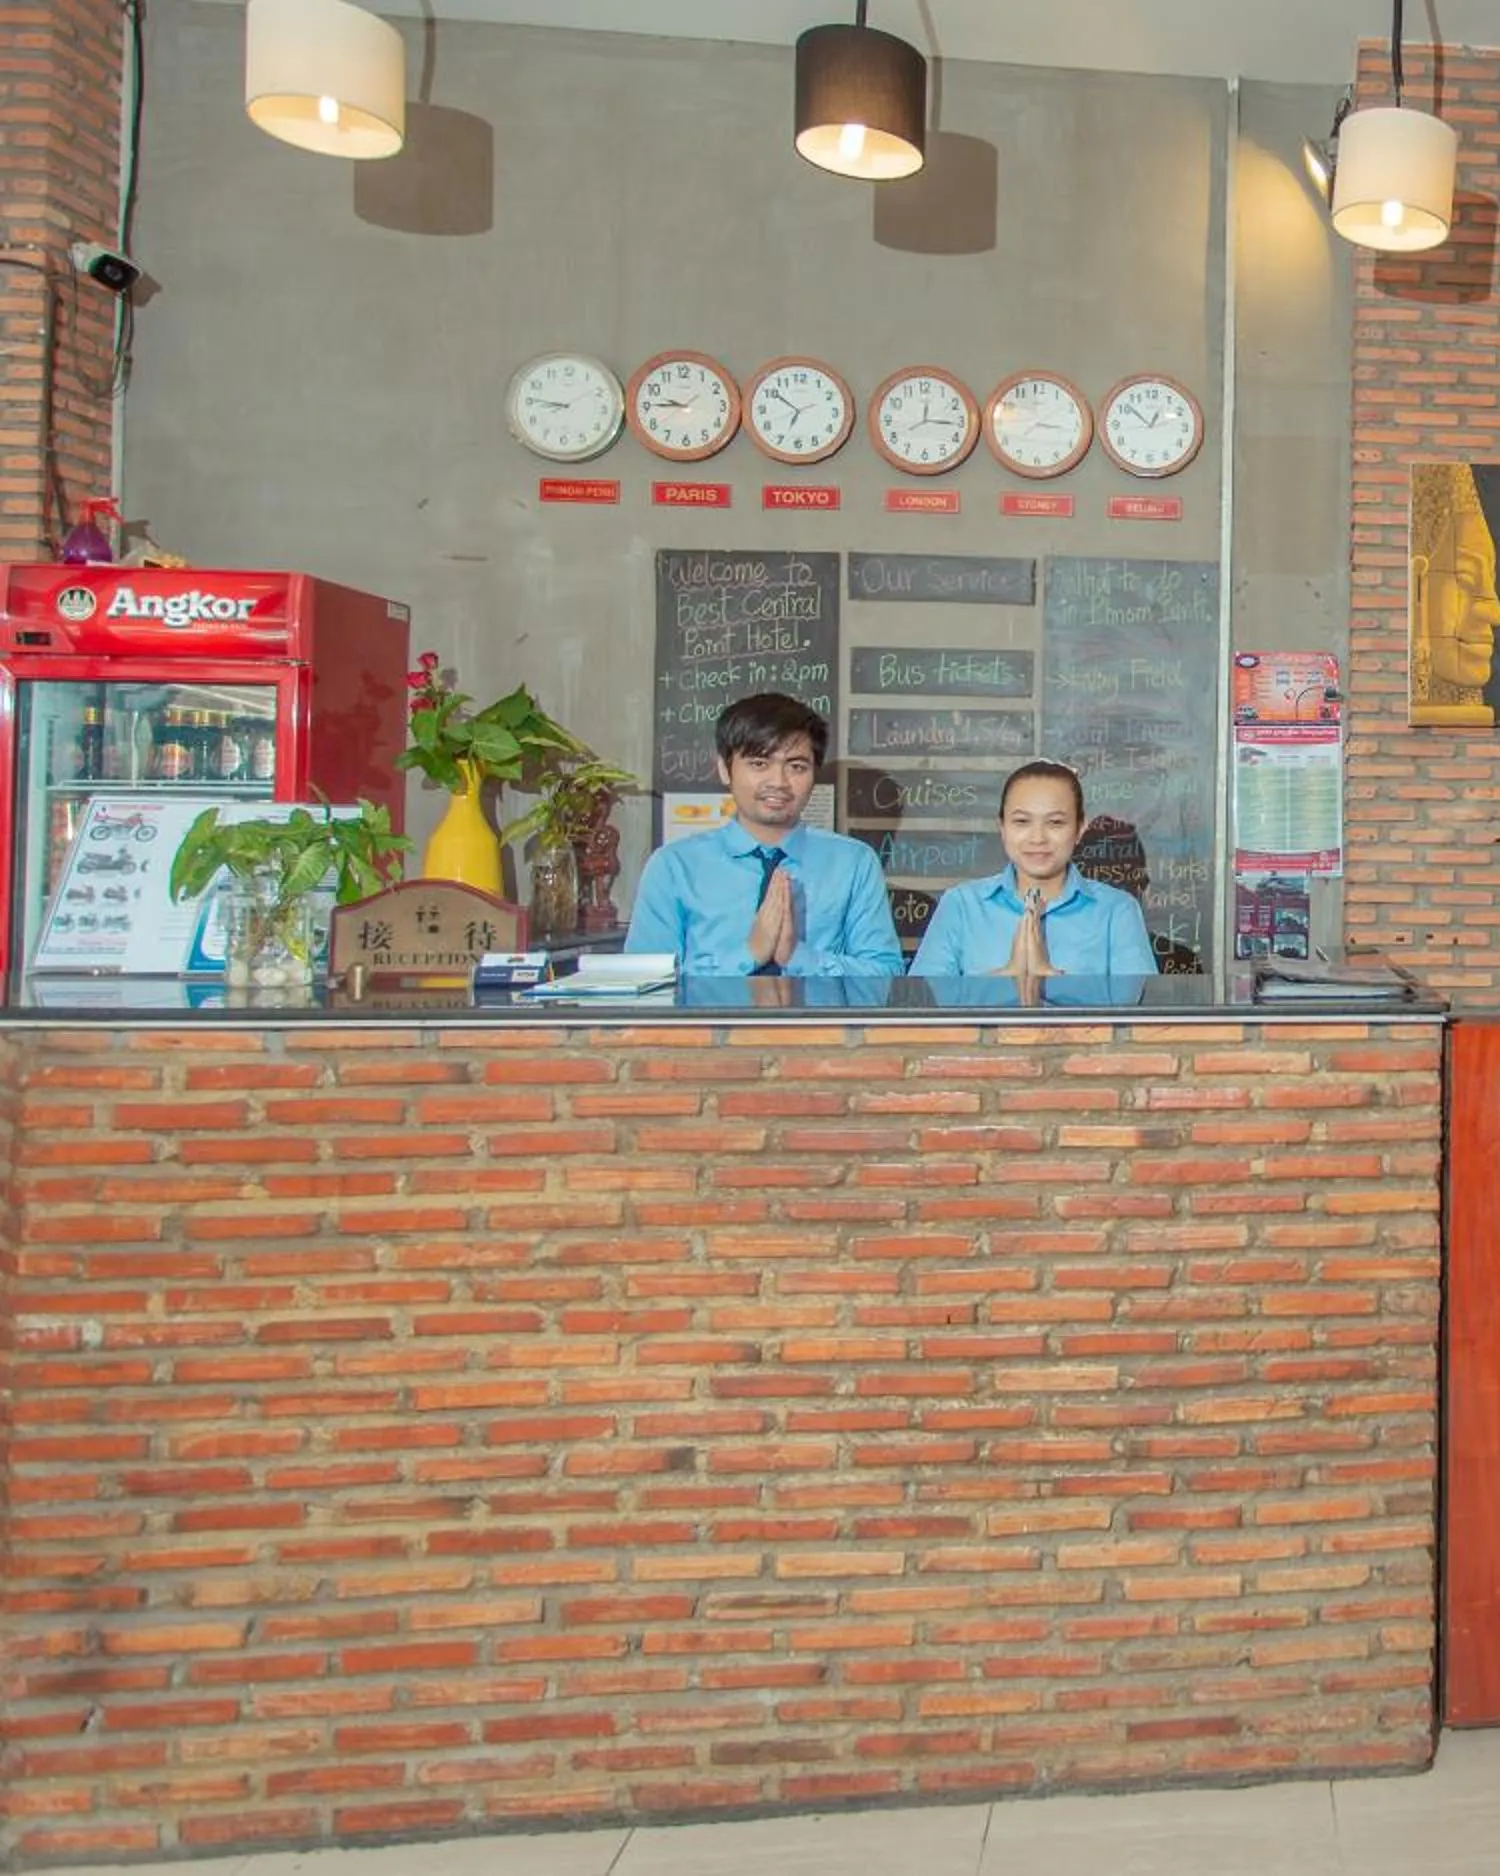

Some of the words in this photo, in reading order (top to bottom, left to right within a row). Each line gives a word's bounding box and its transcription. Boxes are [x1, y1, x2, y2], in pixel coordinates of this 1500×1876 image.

[661, 372, 671, 383] 11
[677, 365, 690, 378] 12
[648, 384, 660, 396] 10
[712, 382, 720, 394] 2
[904, 384, 912, 398] 11
[919, 381, 930, 393] 12
[643, 401, 650, 411] 9
[720, 400, 726, 412] 3
[890, 397, 902, 409] 10
[952, 398, 959, 410] 2
[650, 419, 658, 430] 8
[714, 417, 720, 427] 4
[884, 414, 892, 426] 9
[664, 430, 671, 441] 7
[682, 434, 690, 446] 6
[701, 429, 708, 440] 5
[890, 432, 898, 444] 8
[952, 432, 959, 442] 4
[904, 443, 910, 456] 7
[921, 448, 928, 460] 6
[939, 444, 946, 456] 5
[665, 488, 718, 501] PARIS
[772, 492, 829, 506] TOKYO
[862, 559, 915, 593] Our
[107, 587, 258, 627] Angkor
[676, 584, 733, 627] Best
[681, 623, 737, 659] Point
[879, 653, 925, 688] Bus
[873, 772, 978, 810] Cruises
[879, 831, 986, 873] Airport
[358, 919, 393, 950] 接
[464, 919, 497, 950] 待
[373, 952, 480, 966] RECEPTION
